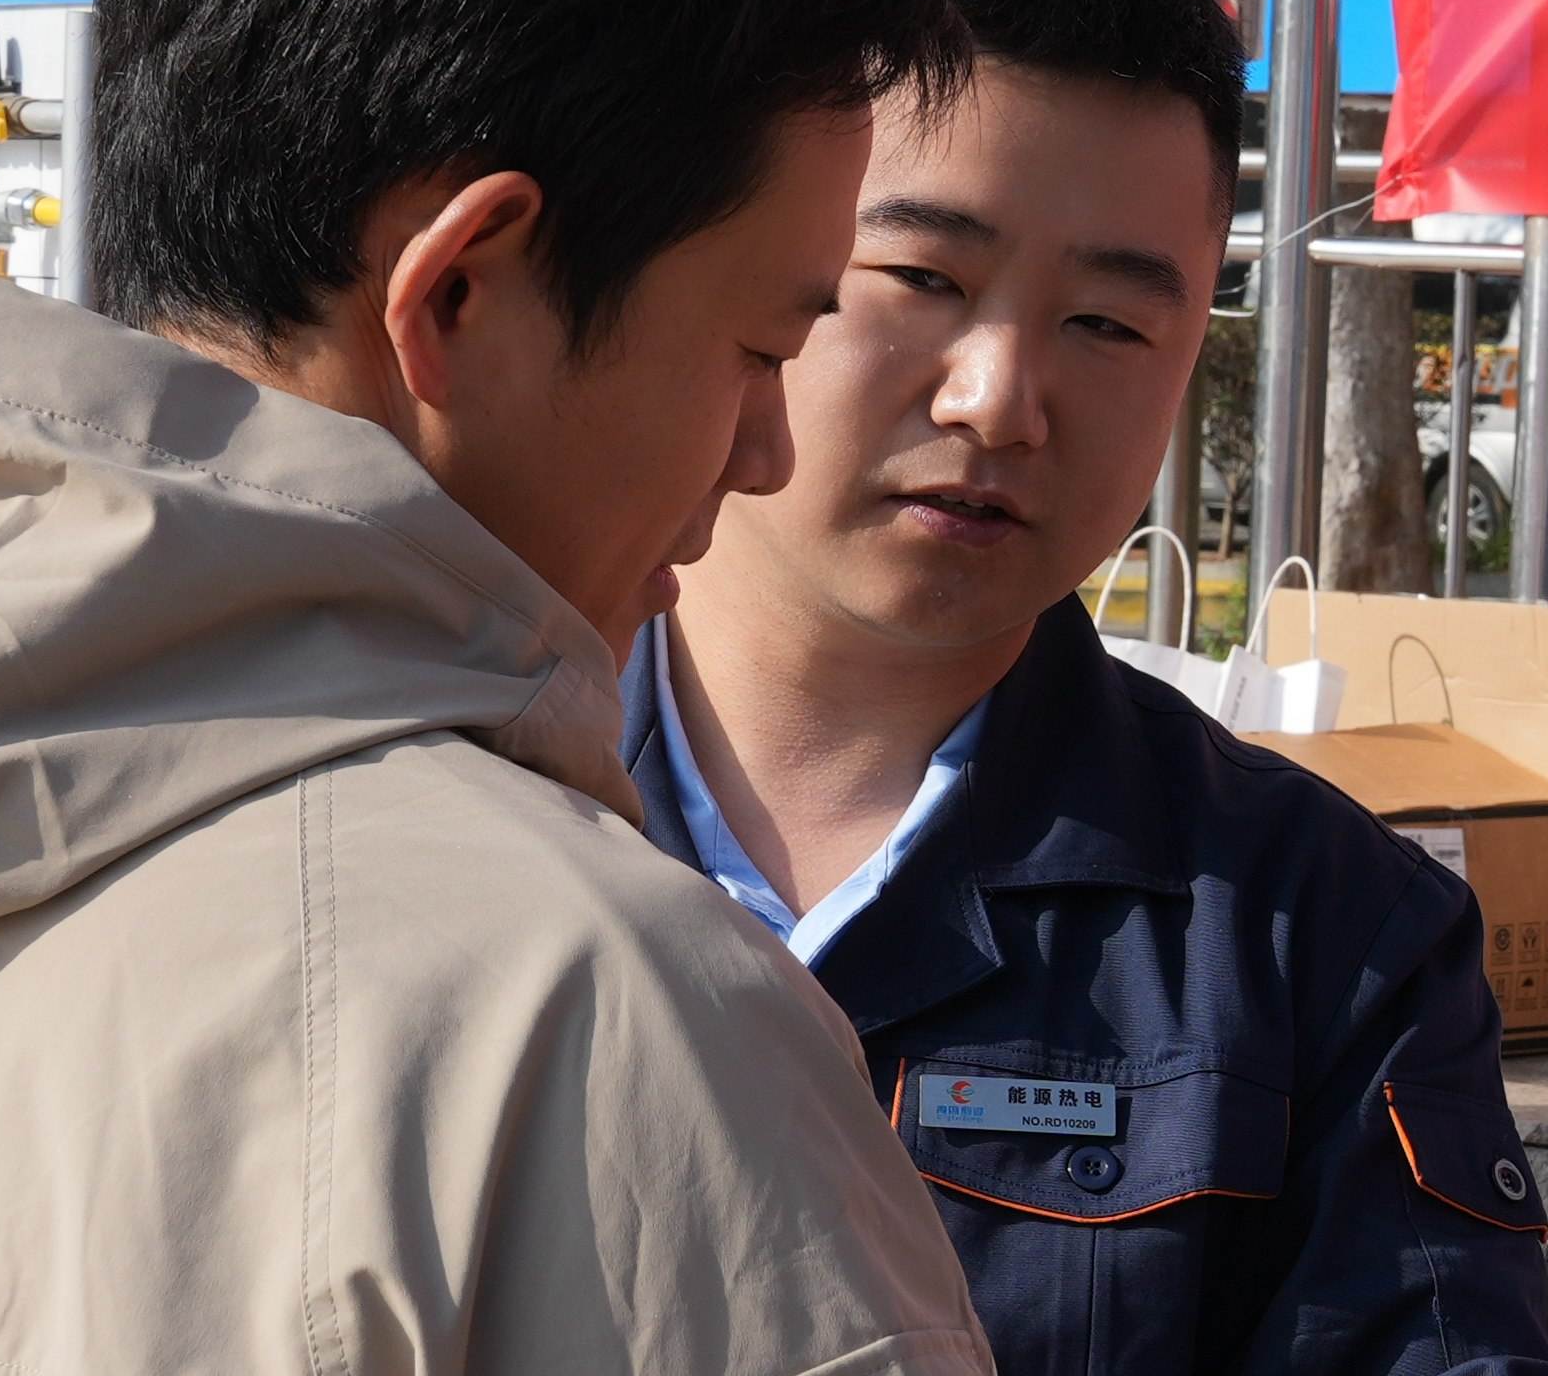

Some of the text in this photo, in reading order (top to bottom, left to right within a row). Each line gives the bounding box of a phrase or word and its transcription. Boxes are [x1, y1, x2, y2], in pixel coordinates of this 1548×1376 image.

[1008, 1086, 1103, 1108] 能源热电
[1022, 1116, 1097, 1130] NO.RD10209
